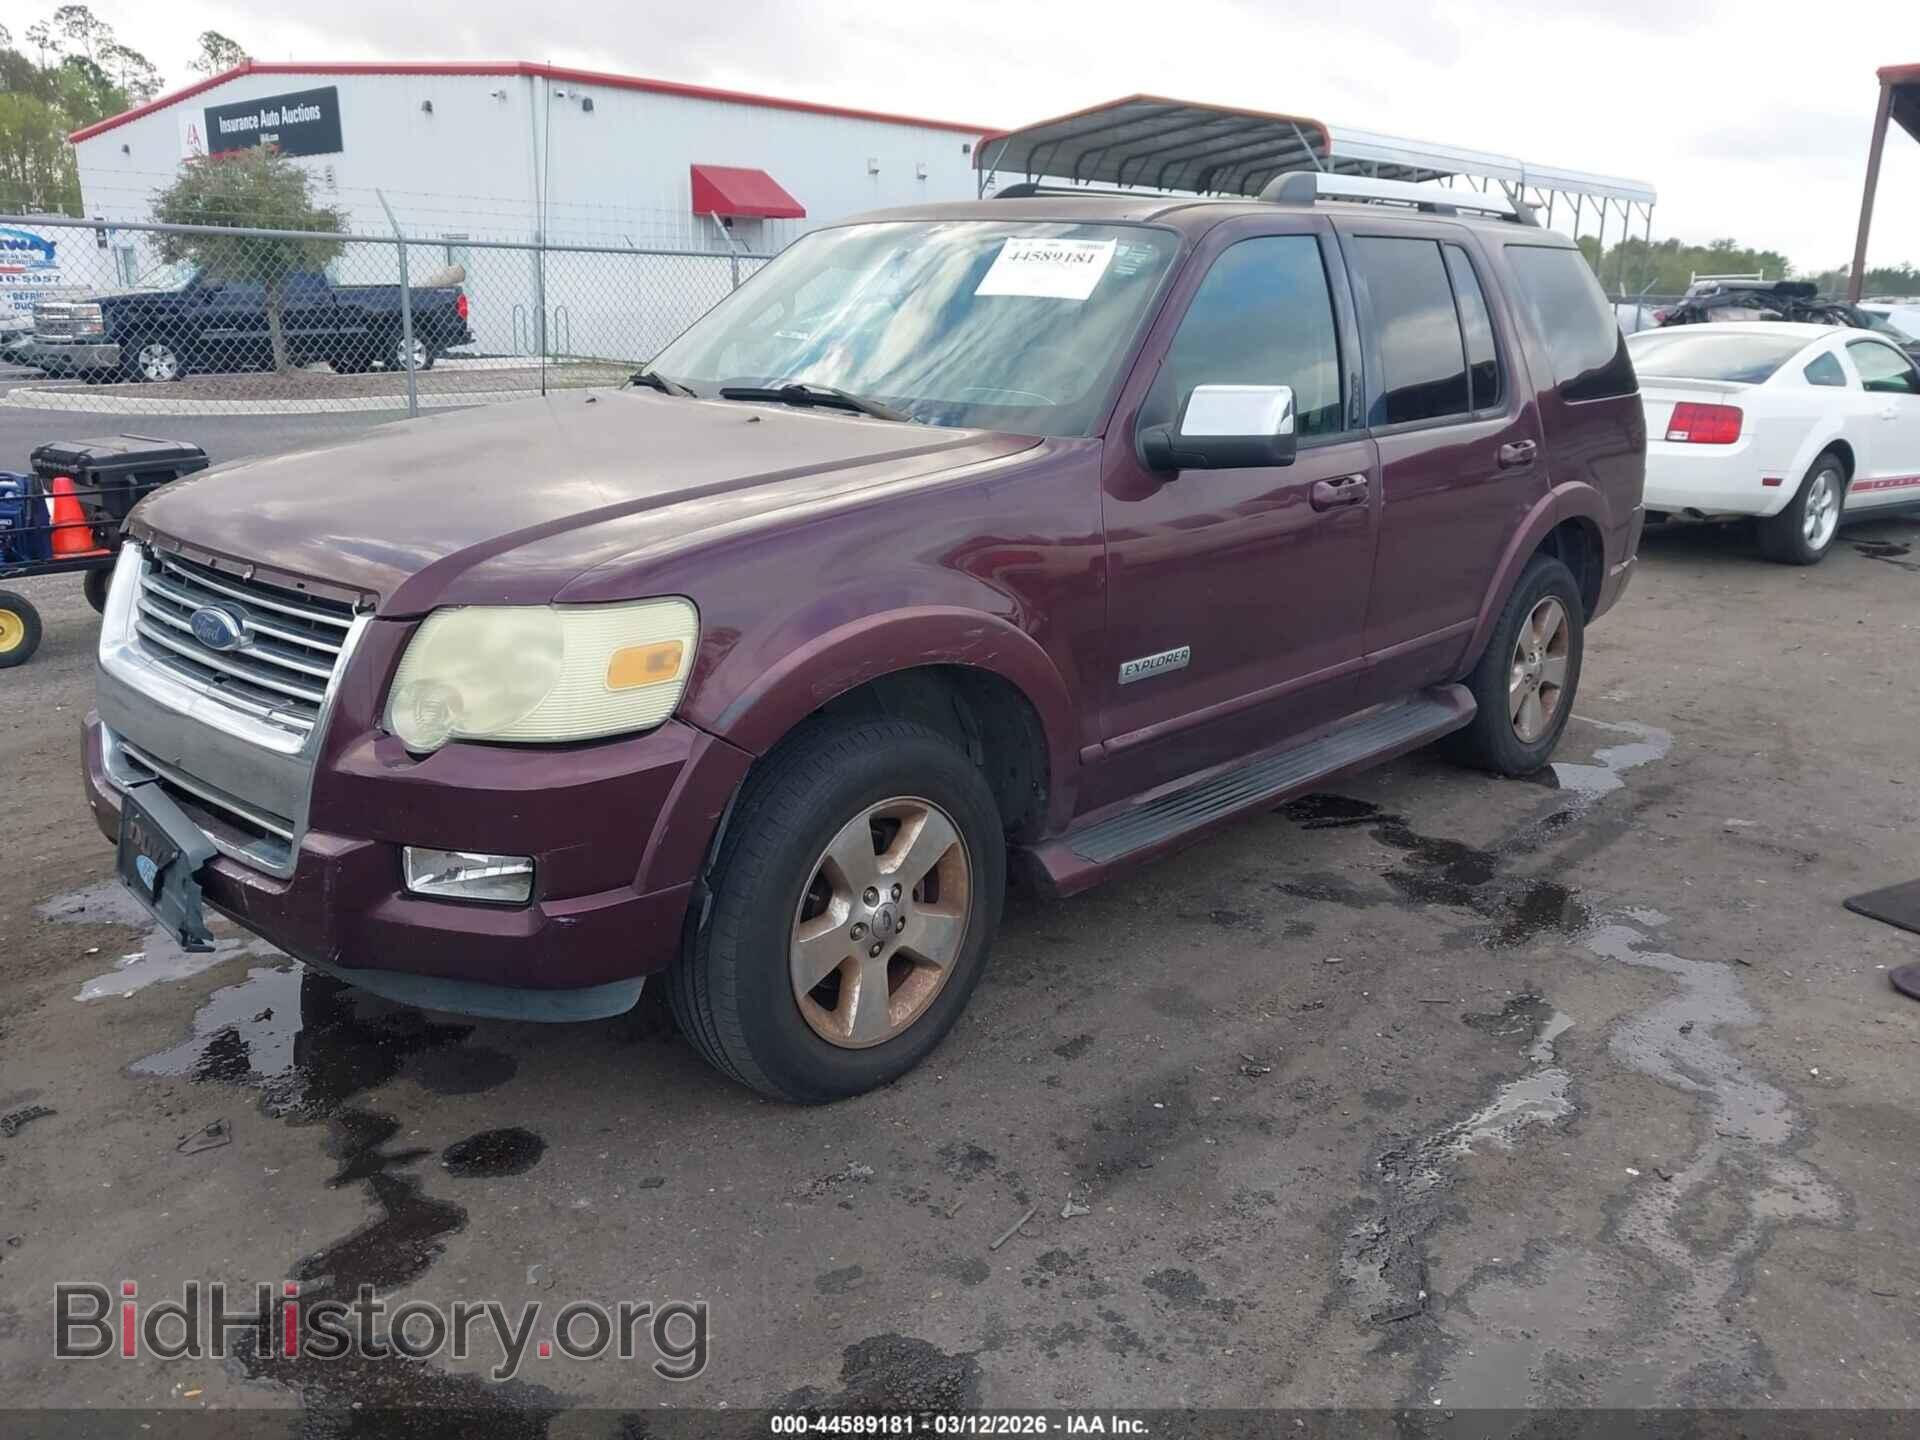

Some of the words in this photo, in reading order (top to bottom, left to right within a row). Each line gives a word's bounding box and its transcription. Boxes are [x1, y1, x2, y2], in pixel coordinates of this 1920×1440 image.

[218, 115, 259, 133] Insurance
[261, 109, 280, 128] Auto
[281, 102, 321, 125] Auctions
[1008, 250, 1096, 264] 44589181
[1124, 649, 1189, 676] EXPLORER
